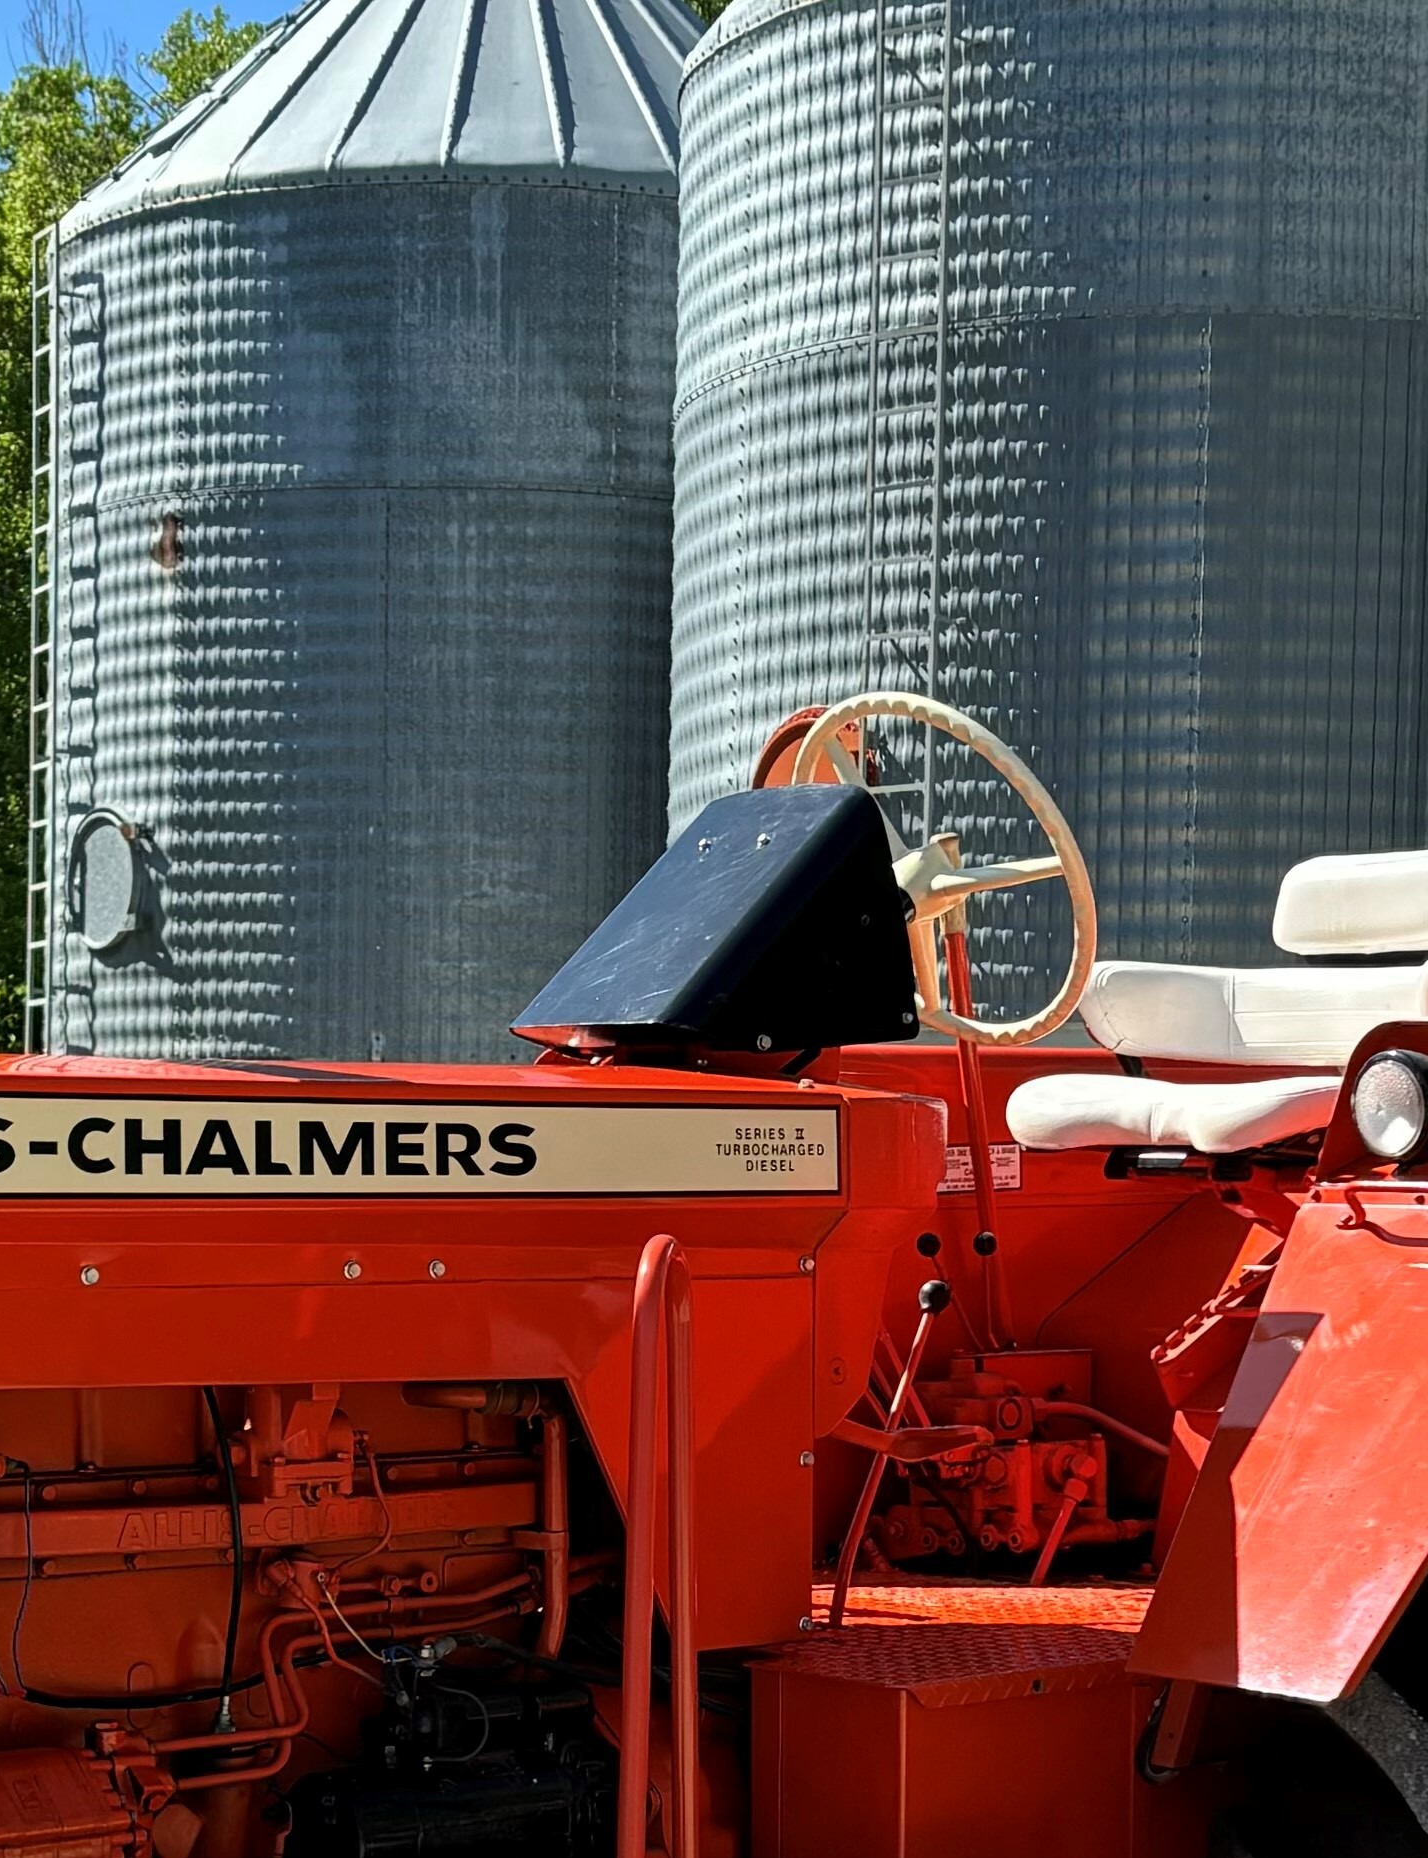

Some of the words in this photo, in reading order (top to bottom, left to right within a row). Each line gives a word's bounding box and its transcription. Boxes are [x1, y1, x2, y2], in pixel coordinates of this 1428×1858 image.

[735, 1127, 786, 1140] SERIES
[715, 1143, 825, 1156] TURBOCHARGED
[745, 1159, 796, 1172] DIESEL
